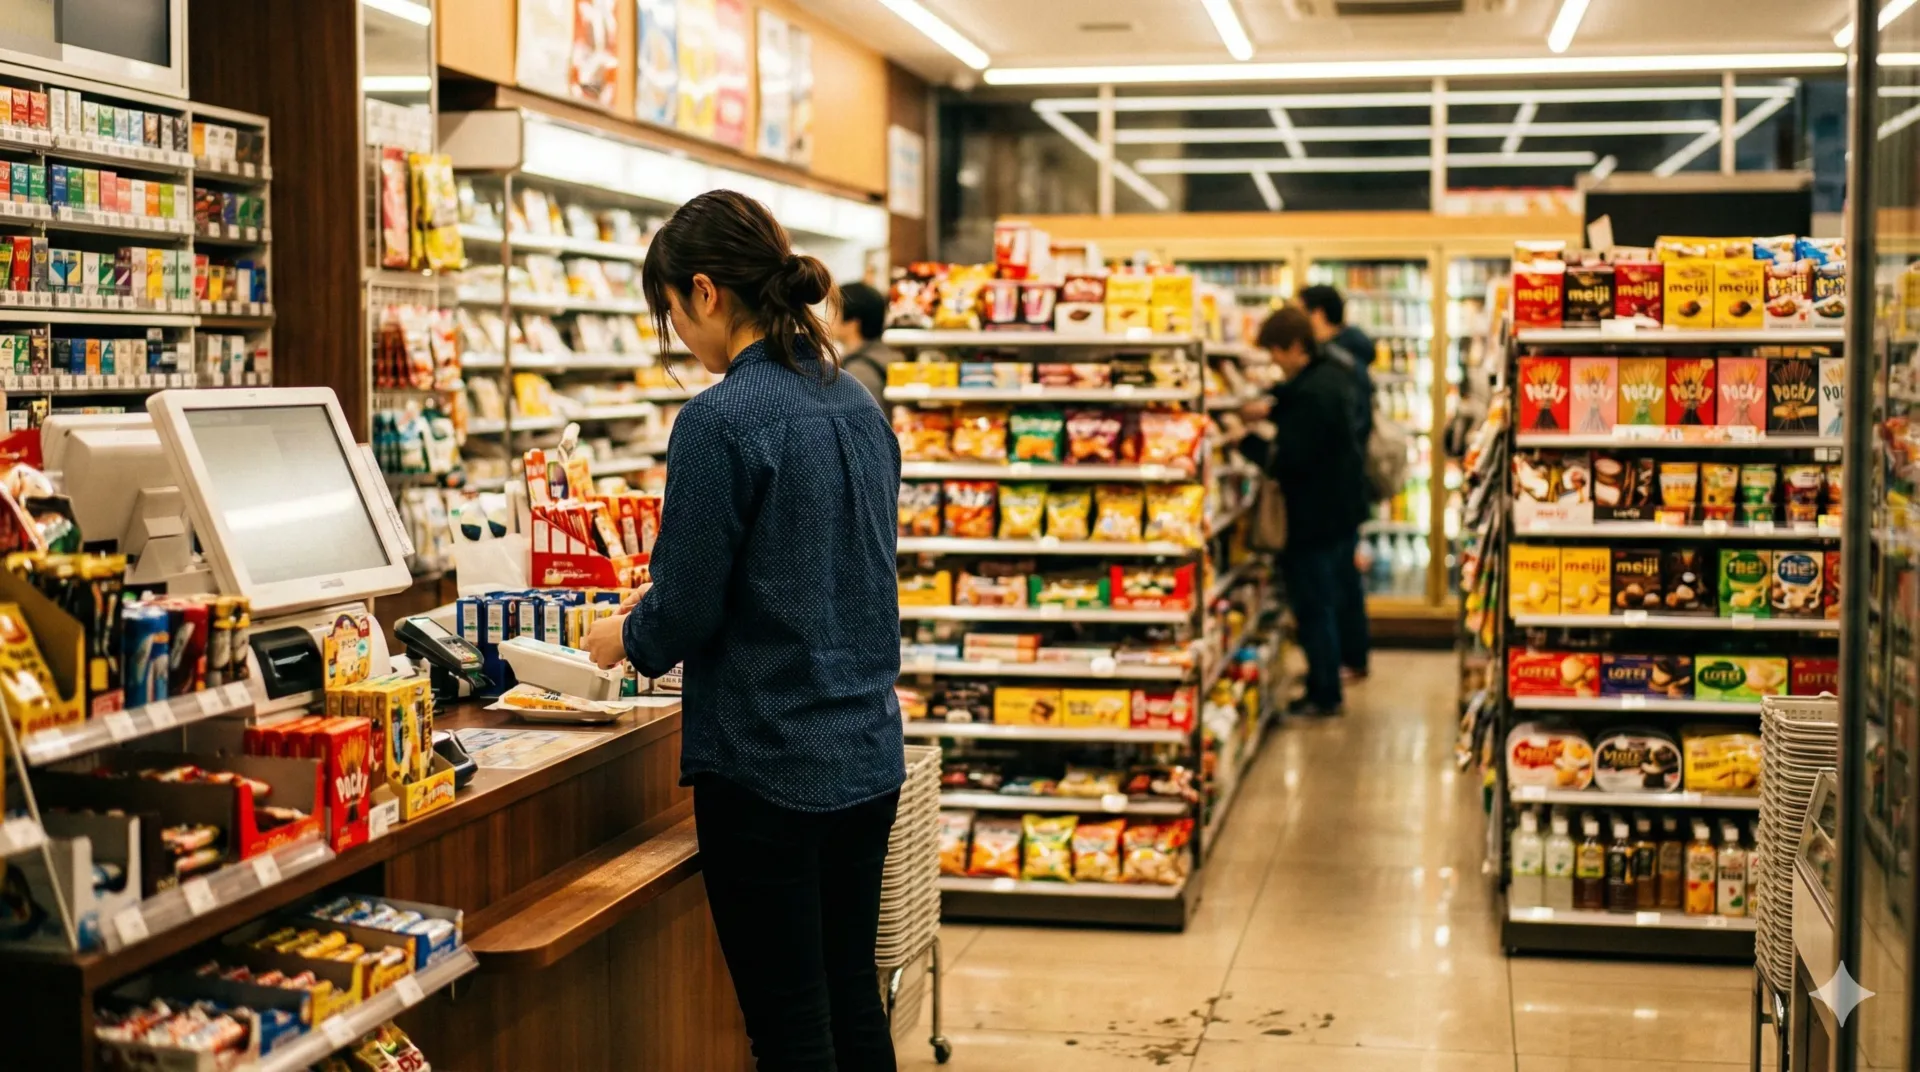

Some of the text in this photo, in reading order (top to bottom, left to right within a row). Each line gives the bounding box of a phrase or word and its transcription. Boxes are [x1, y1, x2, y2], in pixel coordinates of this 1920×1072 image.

[1518, 286, 1559, 304] meiji
[1568, 286, 1609, 304] meiji
[1618, 281, 1659, 300] meiji
[1669, 280, 1709, 296] meiji
[1719, 280, 1759, 296] meiji
[1721, 382, 1764, 404] POCKY
[1772, 382, 1816, 404] POCKY
[1514, 556, 1556, 574] meiji
[1565, 557, 1606, 574] meiji
[1616, 558, 1659, 576] meiji
[336, 767, 369, 804] POCKY
